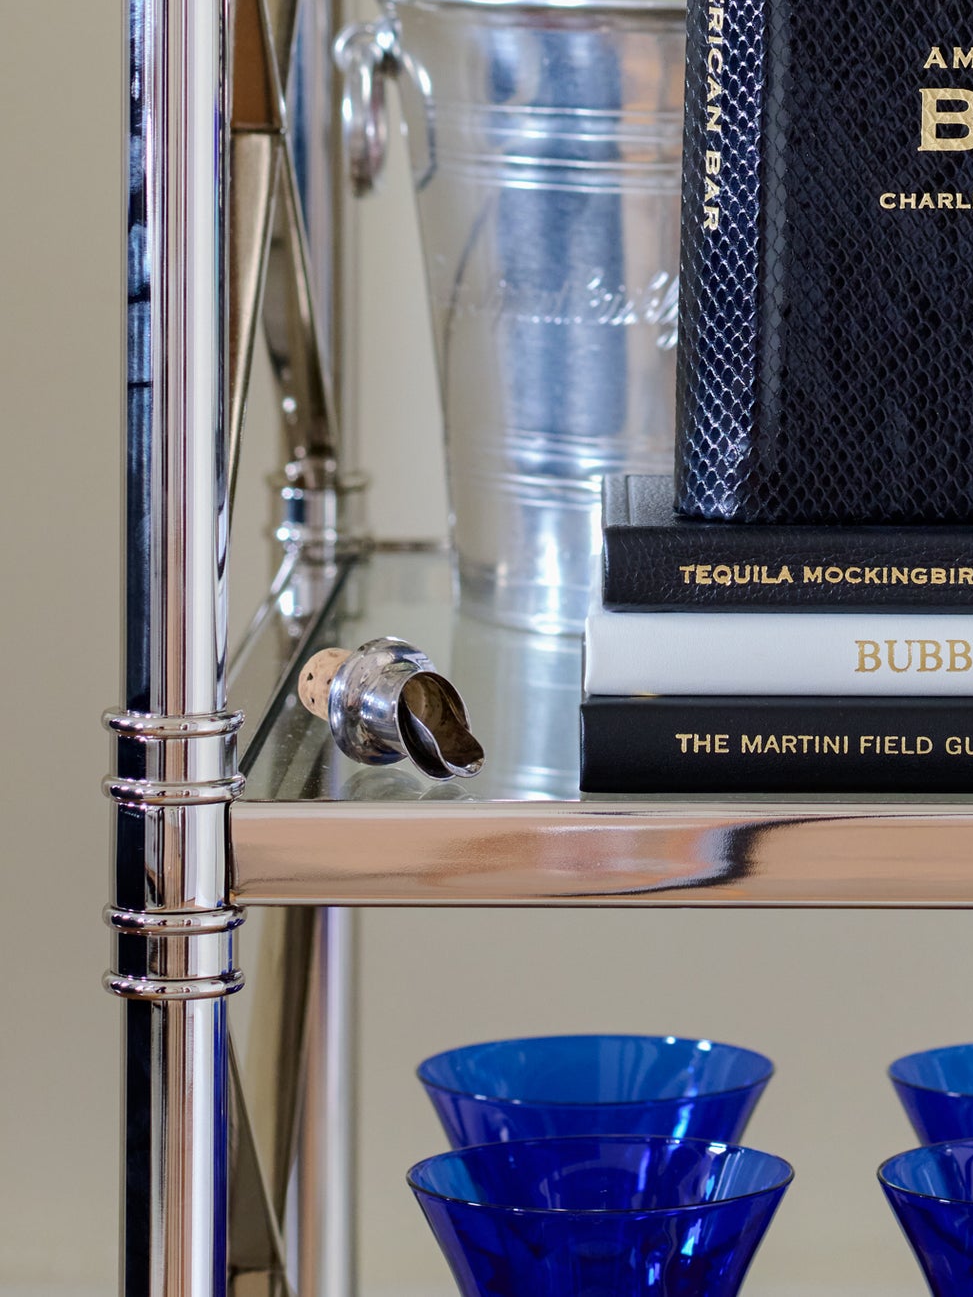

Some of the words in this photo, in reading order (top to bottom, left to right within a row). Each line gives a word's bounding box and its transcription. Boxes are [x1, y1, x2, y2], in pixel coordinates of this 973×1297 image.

[703, 149, 721, 231] BAR
[679, 564, 794, 586] TEQUILA
[675, 733, 730, 754] THE
[741, 734, 849, 754] MARTINI
[860, 735, 933, 755] FIELD
